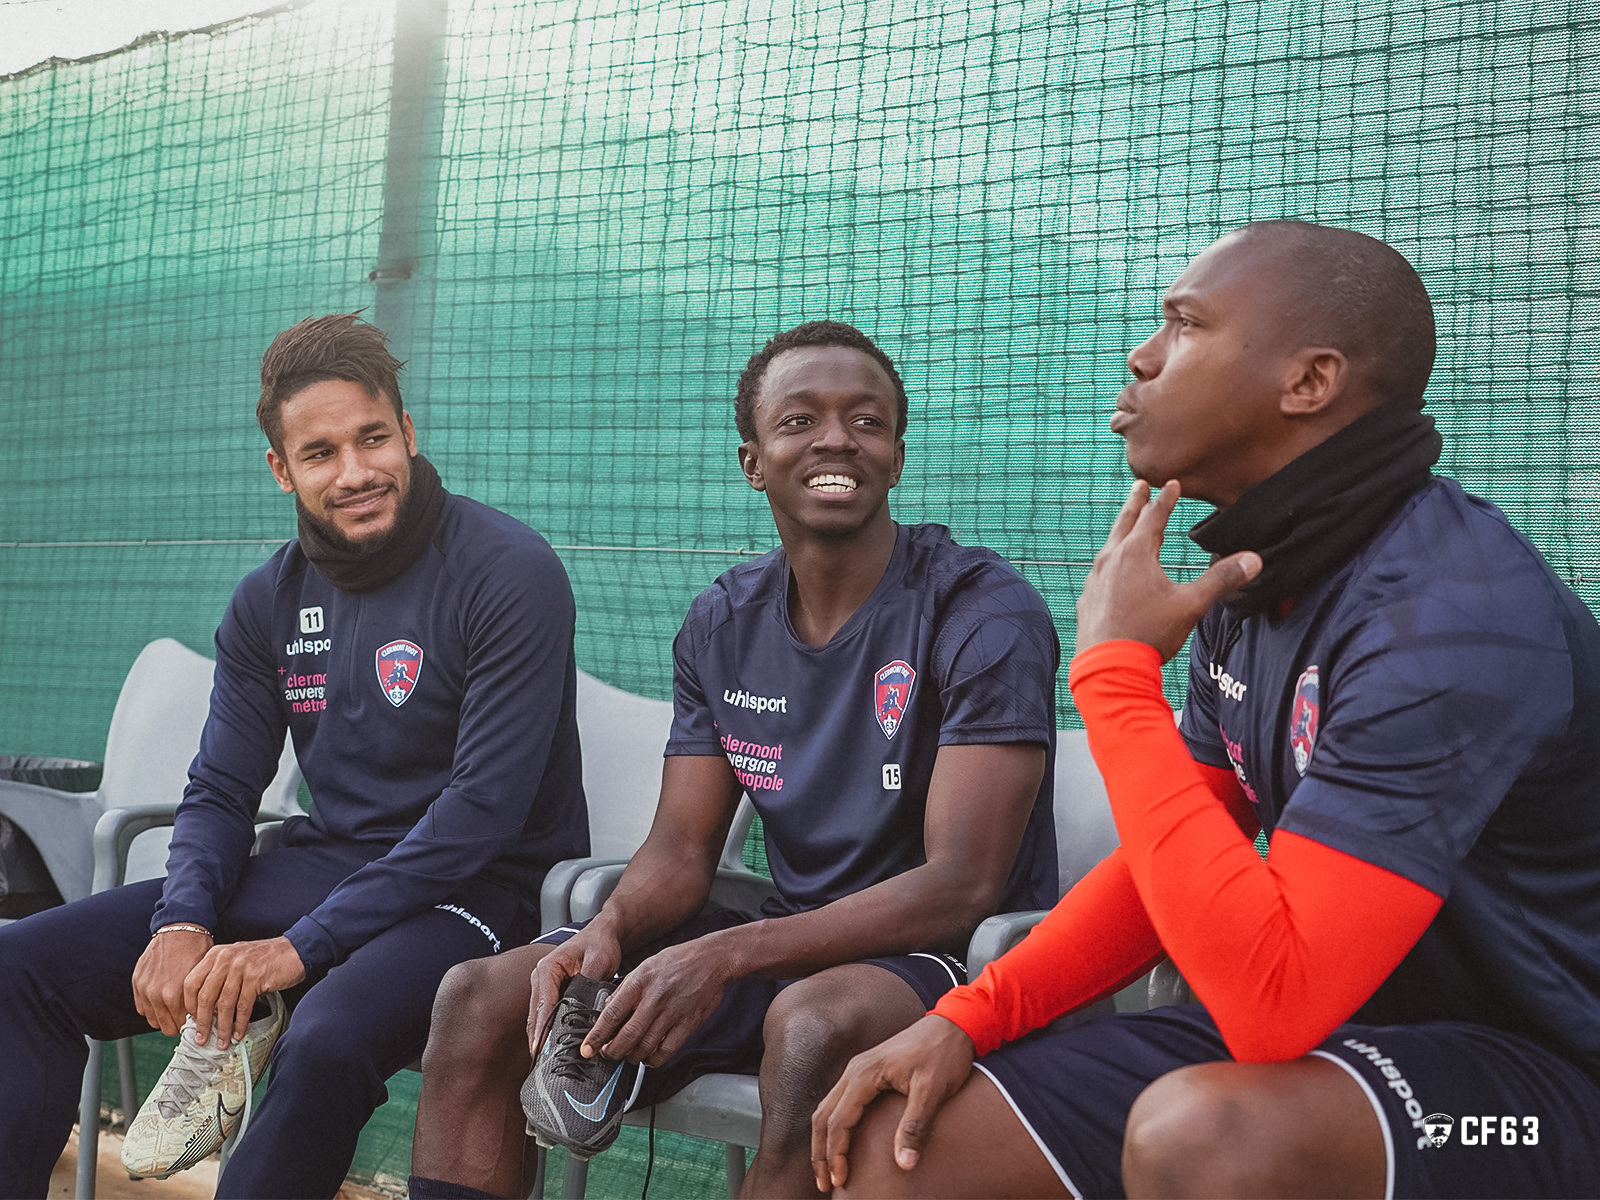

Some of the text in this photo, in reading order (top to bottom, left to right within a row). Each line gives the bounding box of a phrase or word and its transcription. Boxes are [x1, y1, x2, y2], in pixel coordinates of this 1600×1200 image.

[304, 611, 320, 629] 11
[284, 686, 326, 701] auverg
[391, 691, 403, 700] 63
[723, 689, 787, 714] uhlsport
[720, 733, 783, 760] clermont
[726, 752, 777, 774] vergne
[734, 768, 784, 792] tropole
[885, 768, 900, 786] 15
[434, 903, 501, 953] uhlsport
